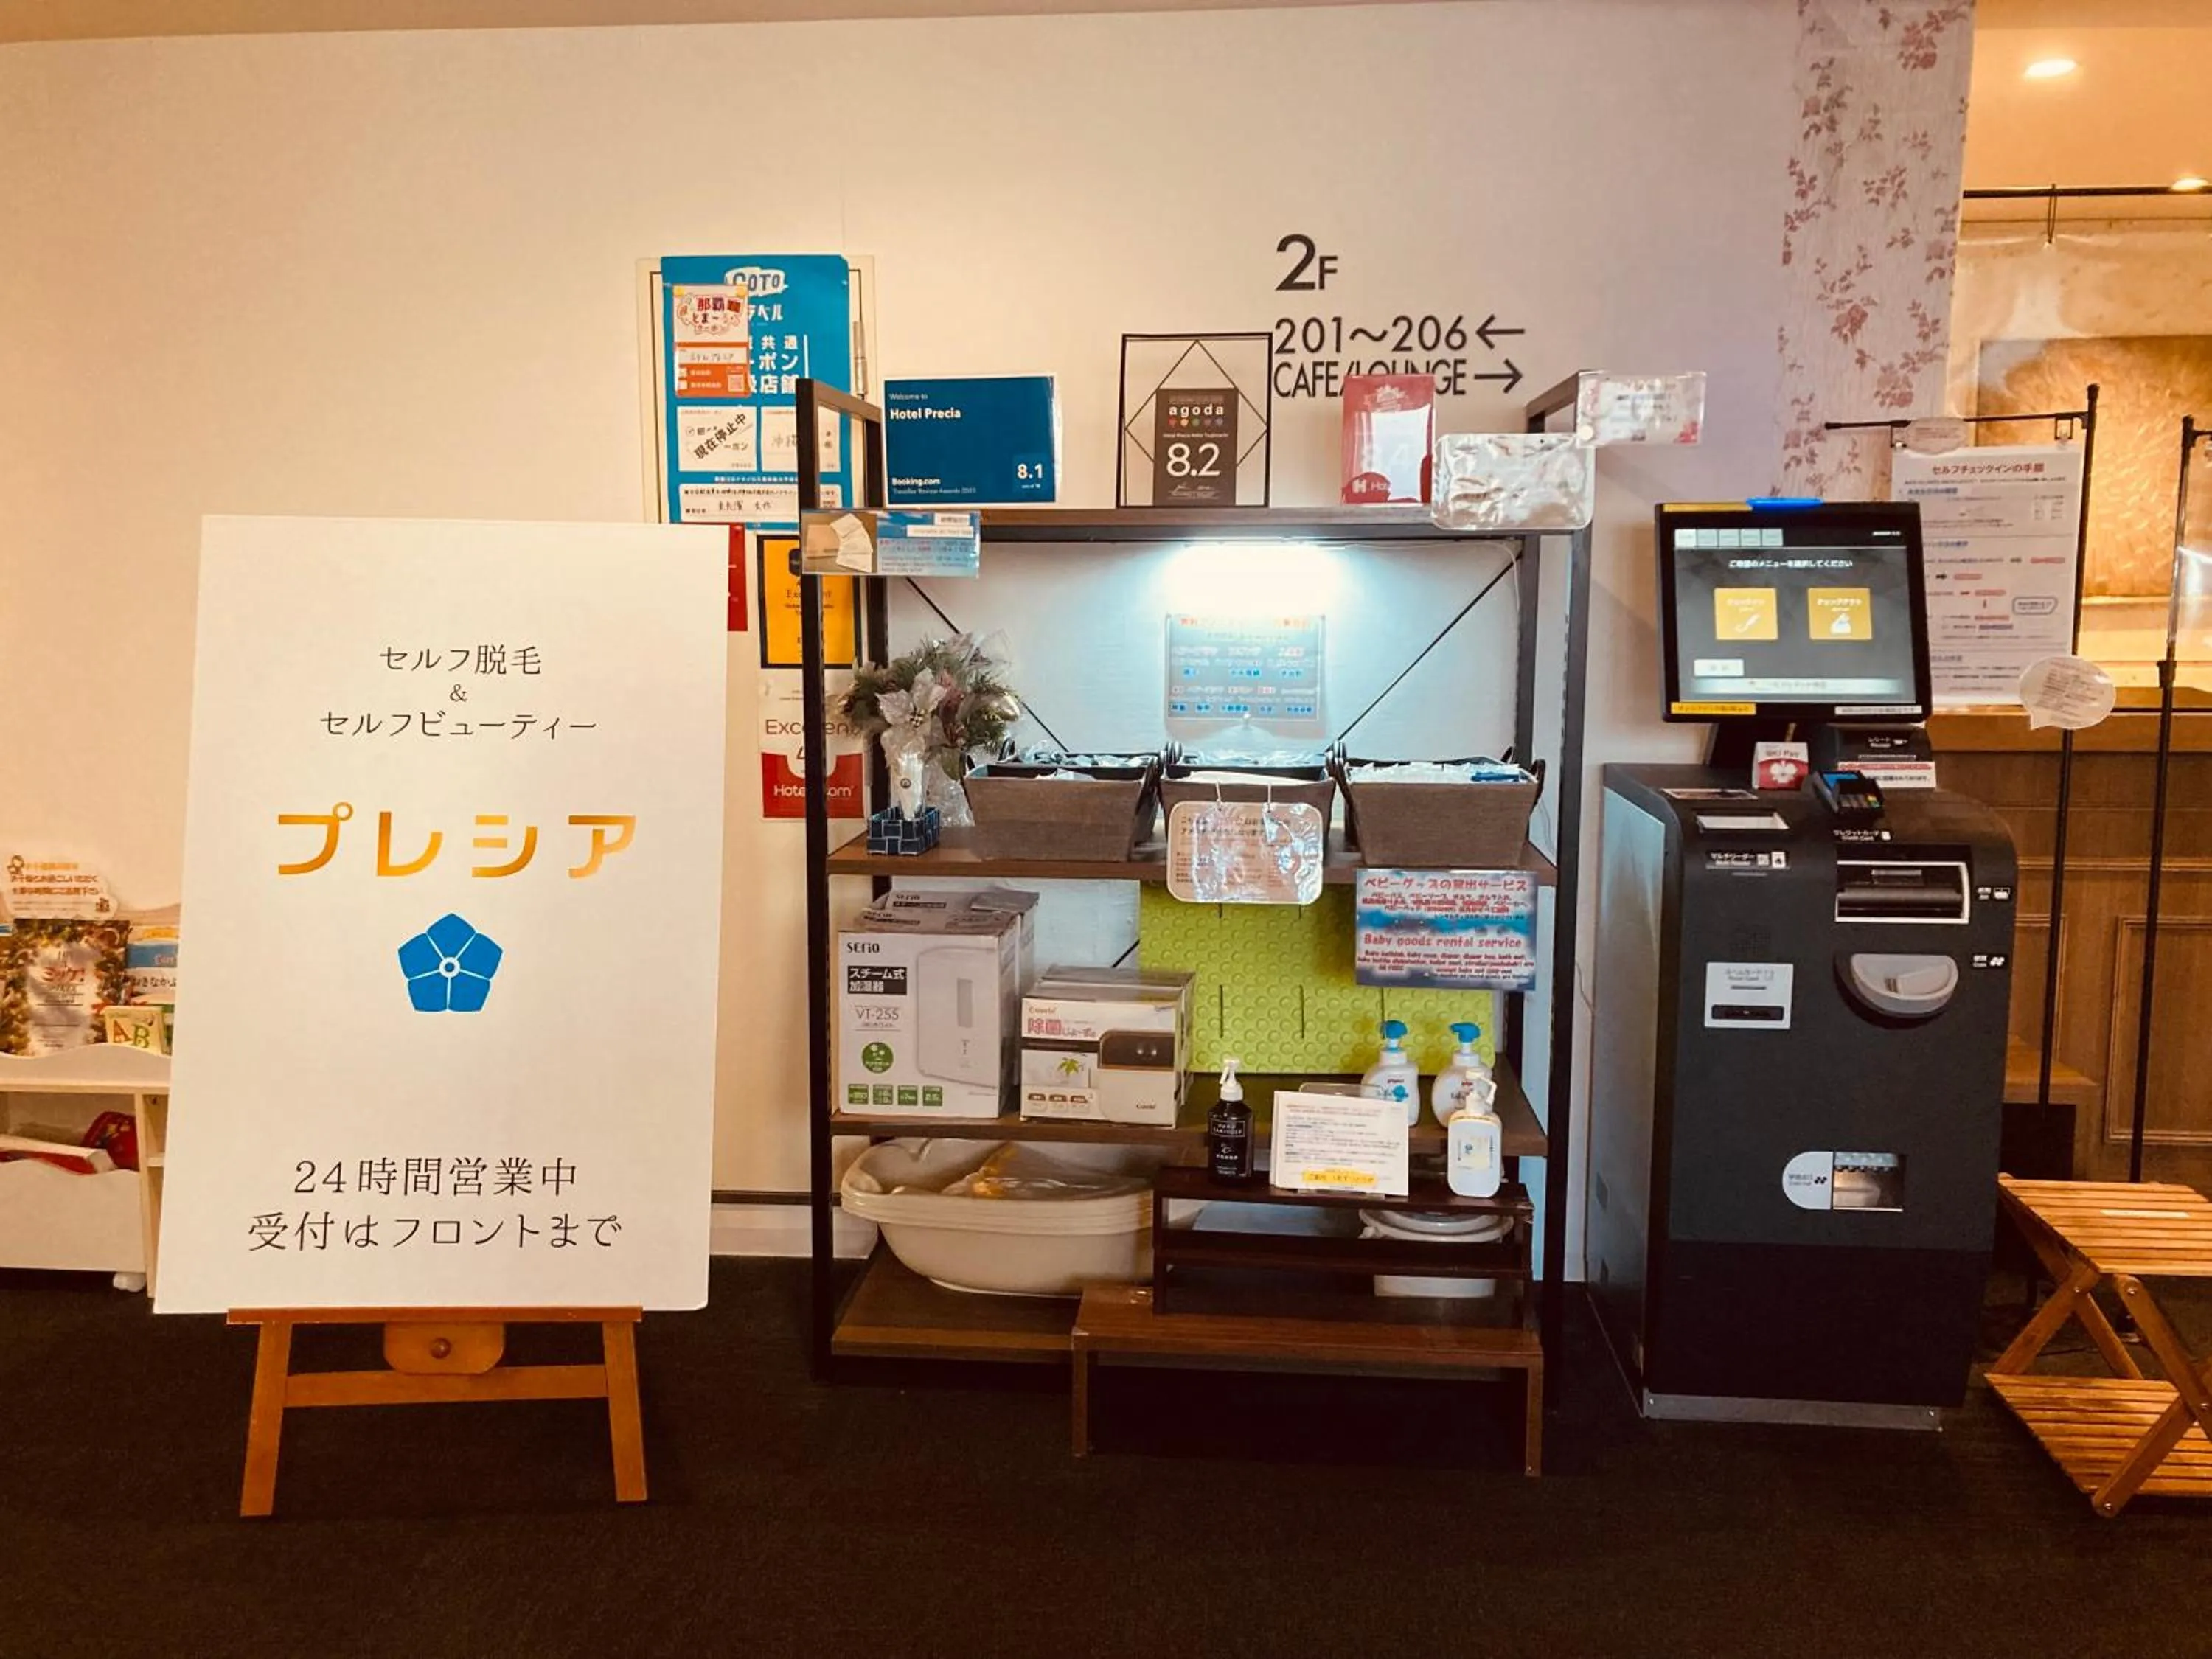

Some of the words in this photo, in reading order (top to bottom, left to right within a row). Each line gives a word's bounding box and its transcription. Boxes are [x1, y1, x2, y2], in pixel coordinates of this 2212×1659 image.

[1276, 234, 1338, 291] 2F
[890, 408, 922, 420] Hotel
[925, 407, 961, 419] Precia
[1169, 404, 1224, 418] agoda
[1166, 442, 1221, 477] 8.2
[1017, 463, 1043, 479] 8.1
[891, 477, 941, 487] Booking.com
[380, 644, 542, 675] セルフ脱毛
[449, 684, 467, 702] &
[320, 710, 597, 740] セルフビューティー
[278, 802, 636, 878] プレシア
[1364, 933, 1392, 945] Baby
[1436, 936, 1474, 947] rental
[1477, 937, 1522, 947] service
[849, 968, 905, 980] スチーム式
[855, 1008, 899, 1020] VT-255
[294, 1157, 576, 1197] 24時間営業中
[248, 1211, 622, 1251] 受付はフロントまで
